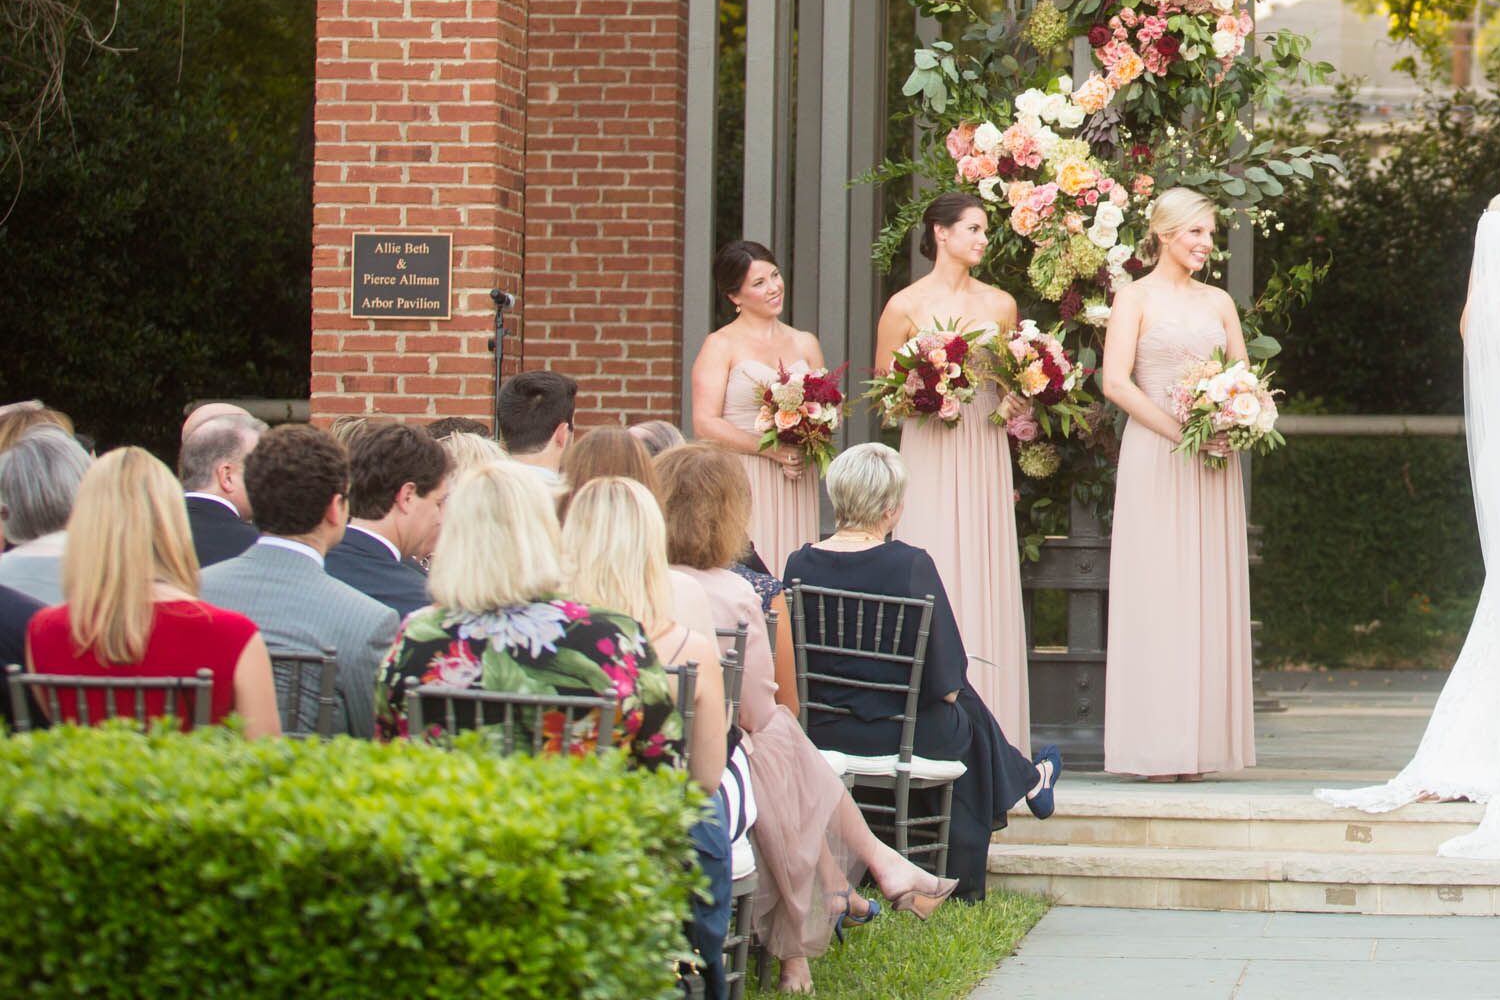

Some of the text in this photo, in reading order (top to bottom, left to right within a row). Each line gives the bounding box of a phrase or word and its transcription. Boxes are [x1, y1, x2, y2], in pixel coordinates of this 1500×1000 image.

[374, 242, 430, 254] Allie Beth
[396, 258, 407, 270] &
[363, 273, 440, 286] Pierce Allman
[361, 297, 440, 309] Arbor Pavilion
